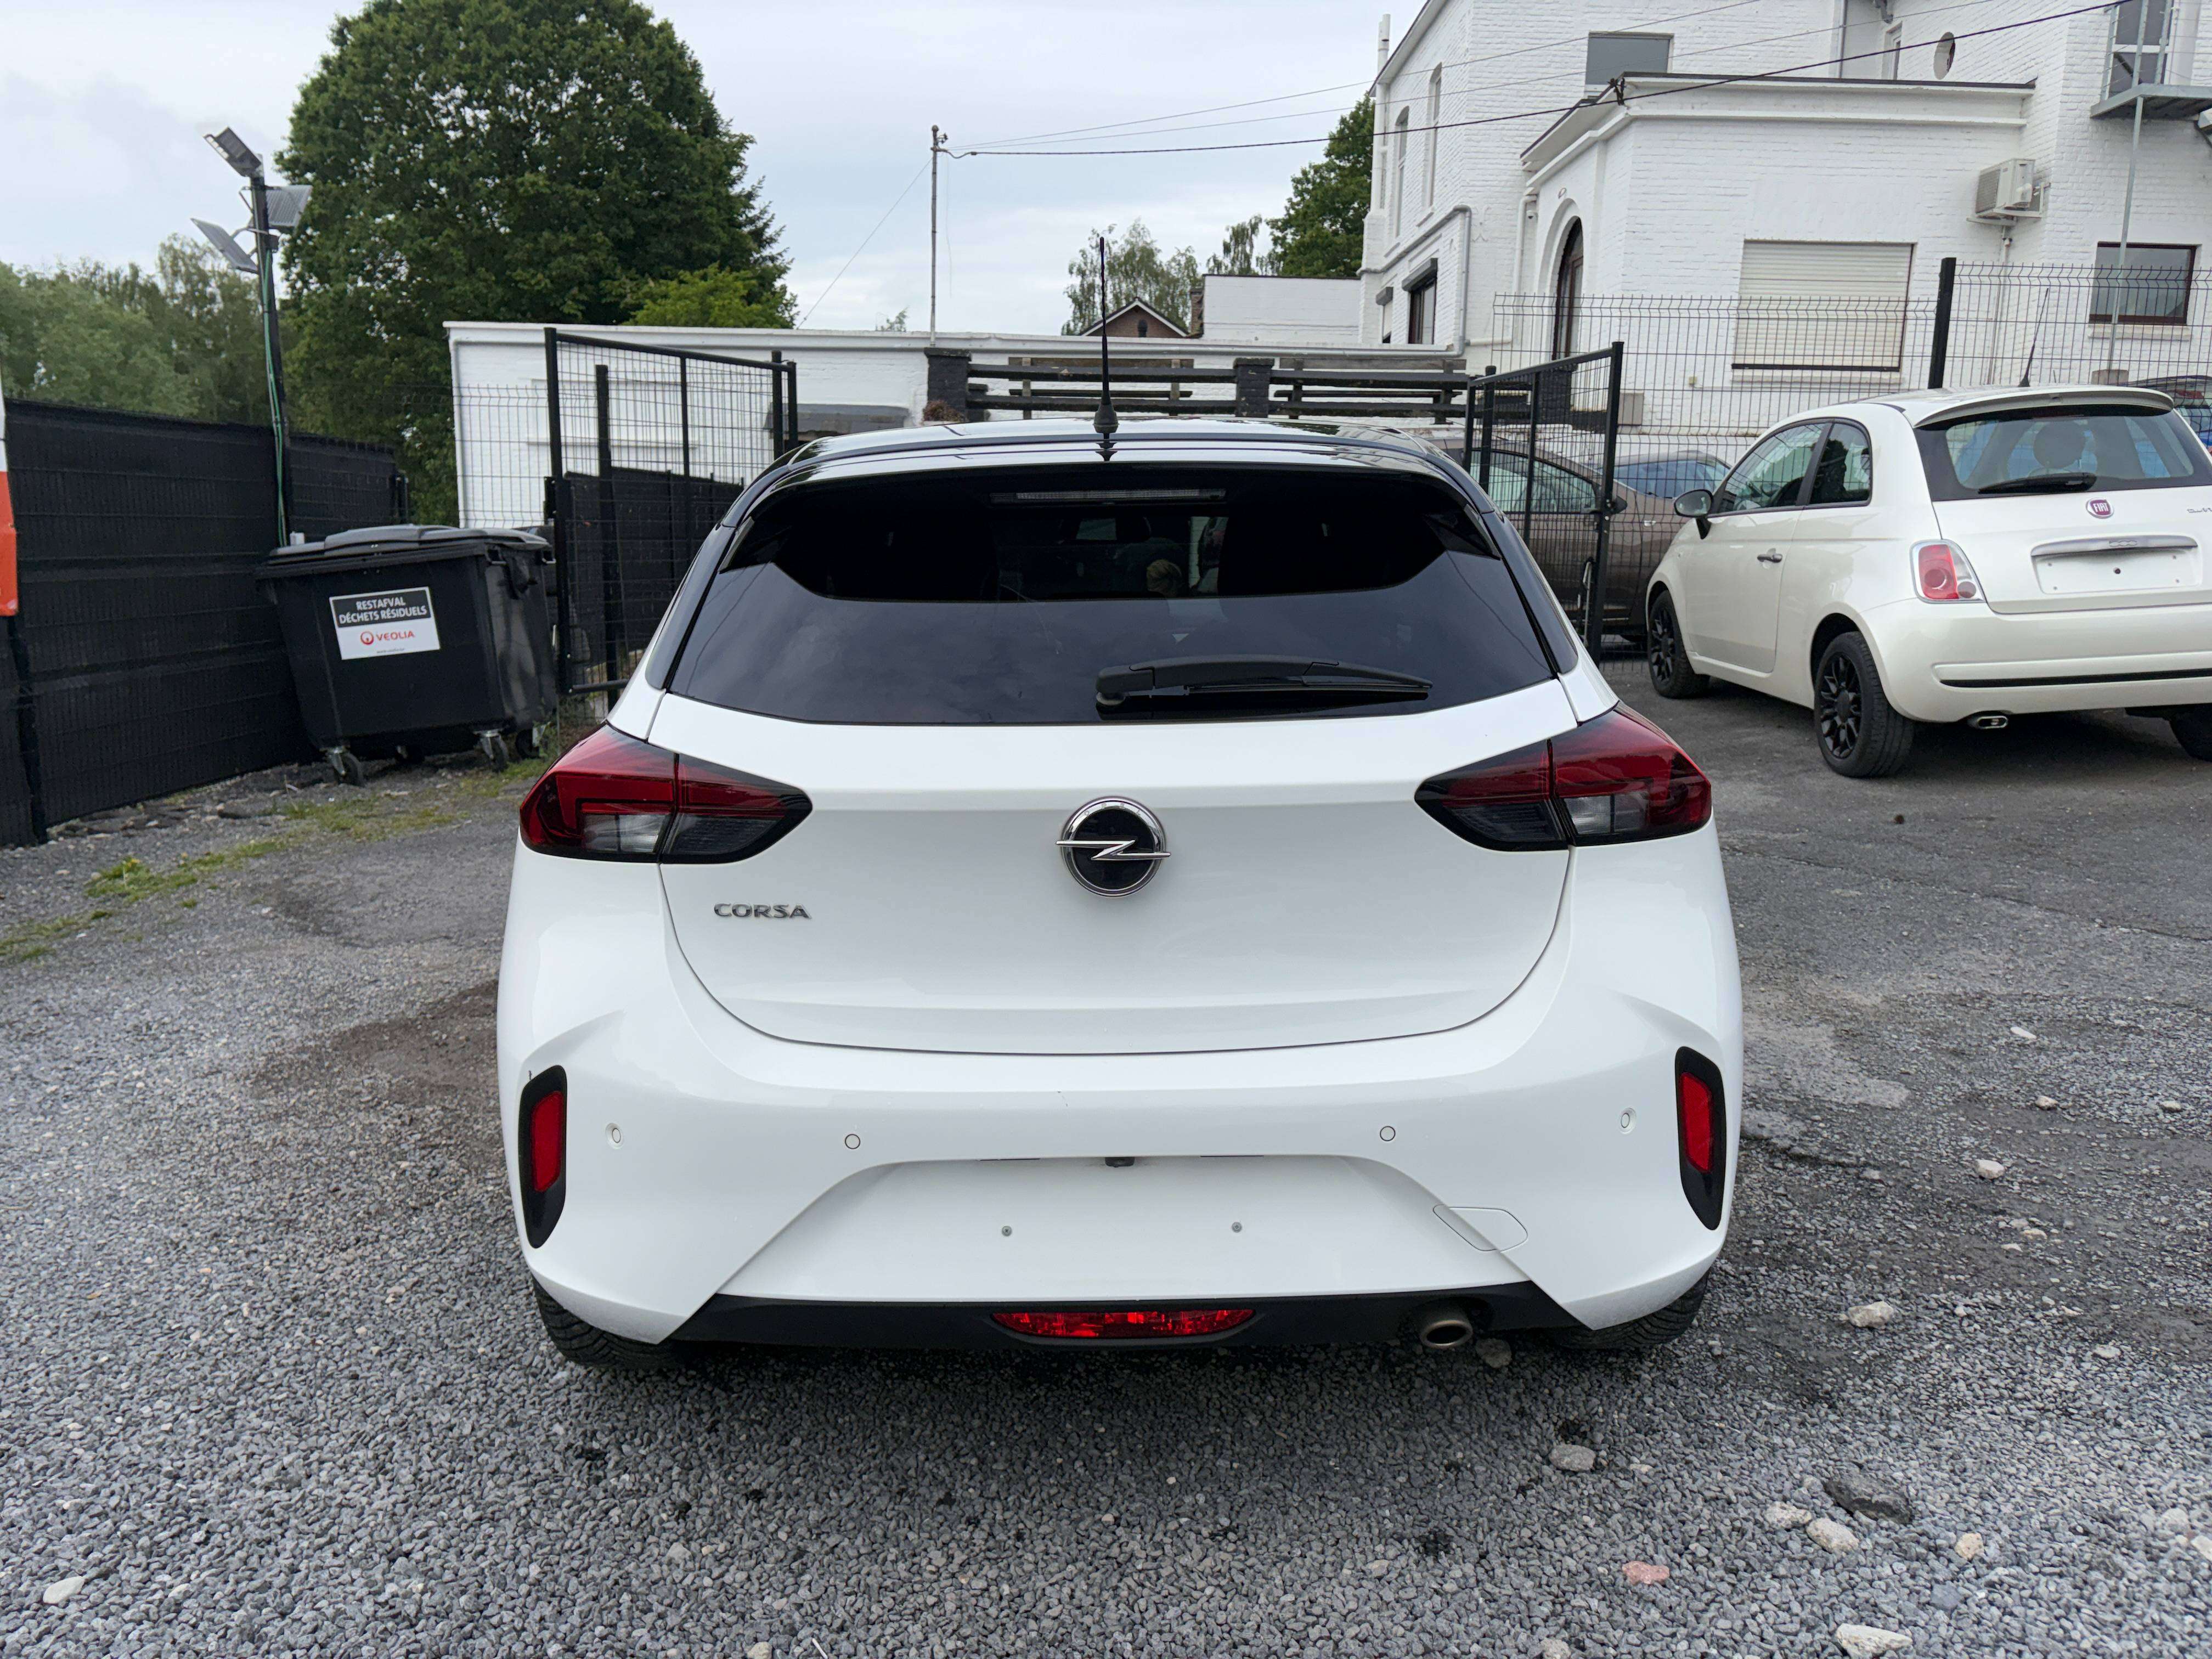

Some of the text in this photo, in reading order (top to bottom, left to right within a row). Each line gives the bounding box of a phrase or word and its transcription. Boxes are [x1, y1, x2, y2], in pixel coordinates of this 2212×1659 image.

[2092, 503, 2109, 512] FIAT
[356, 596, 406, 611] RESTAFVAL
[338, 605, 427, 624] DÉCHETS RÉSIDUELS
[376, 630, 415, 641] VEOLIA
[1084, 803, 1141, 816] OPEL
[714, 903, 811, 919] CORSA
